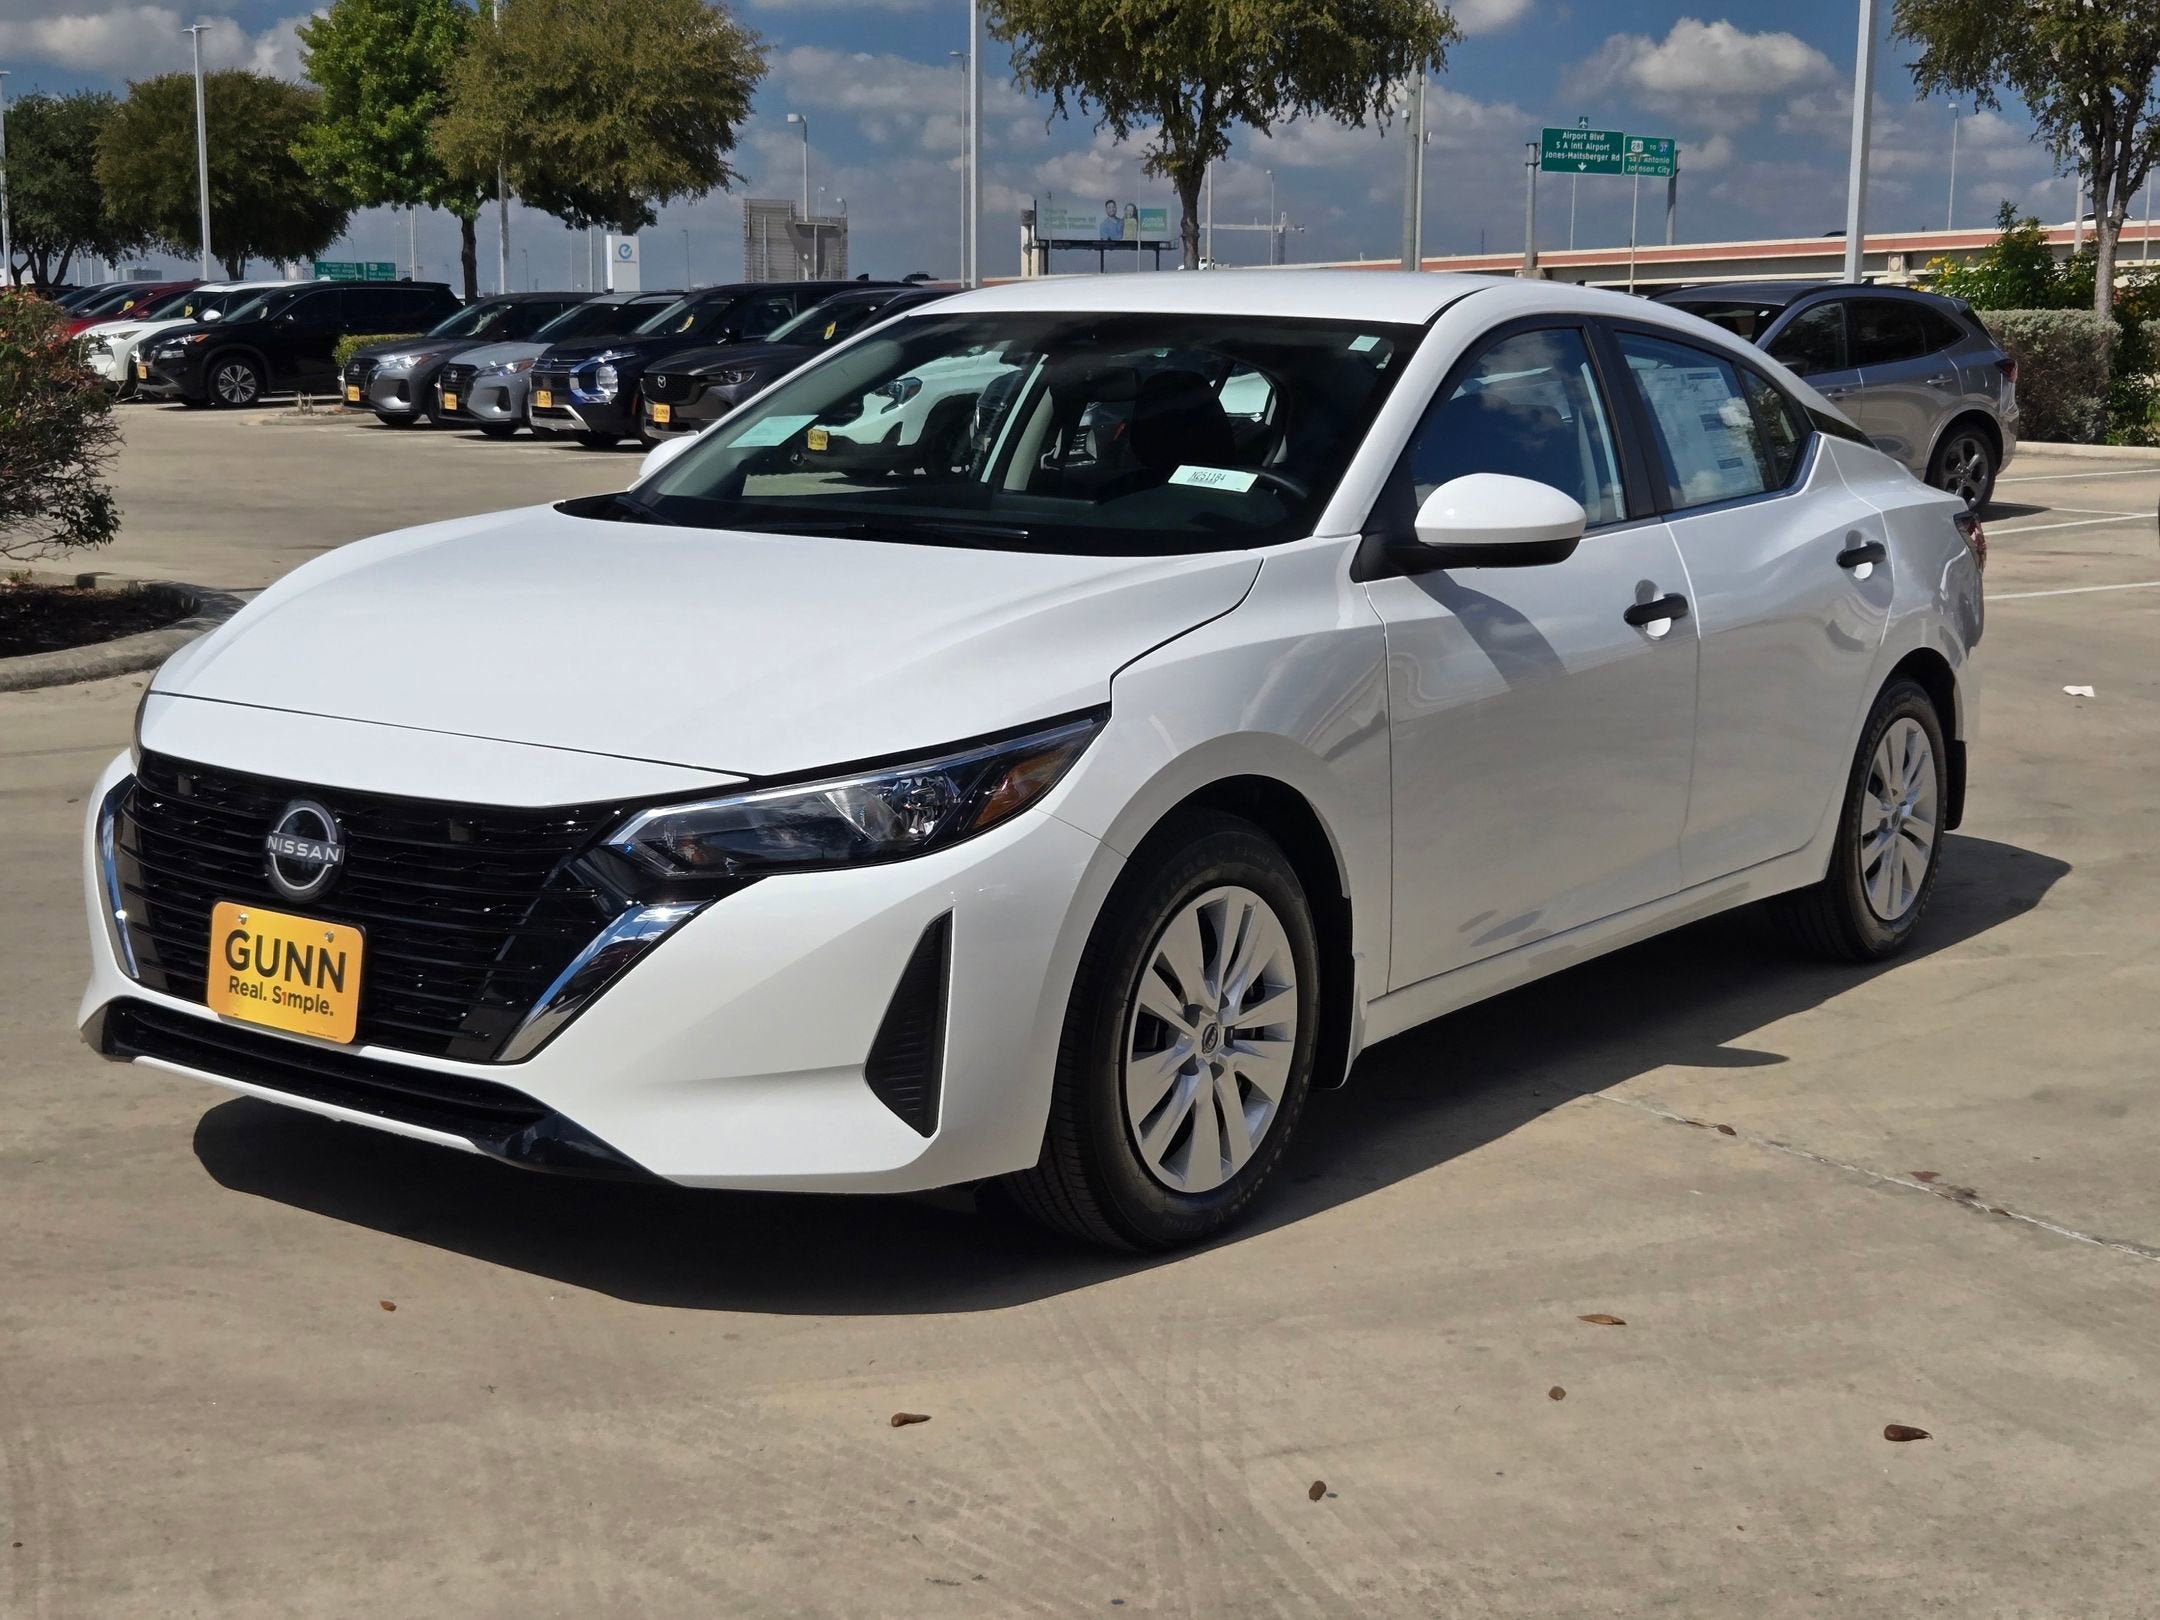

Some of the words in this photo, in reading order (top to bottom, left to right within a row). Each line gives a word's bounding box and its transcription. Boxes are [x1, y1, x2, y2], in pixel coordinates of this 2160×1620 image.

[1562, 132, 1587, 141] Airport
[1590, 133, 1605, 141] Blvd
[1585, 143, 1610, 152] Airport
[1611, 154, 1620, 162] Rd
[1657, 165, 1671, 174] City
[267, 835, 341, 862] NISSAN
[225, 929, 346, 993] GUNN
[229, 975, 268, 1002] Real.
